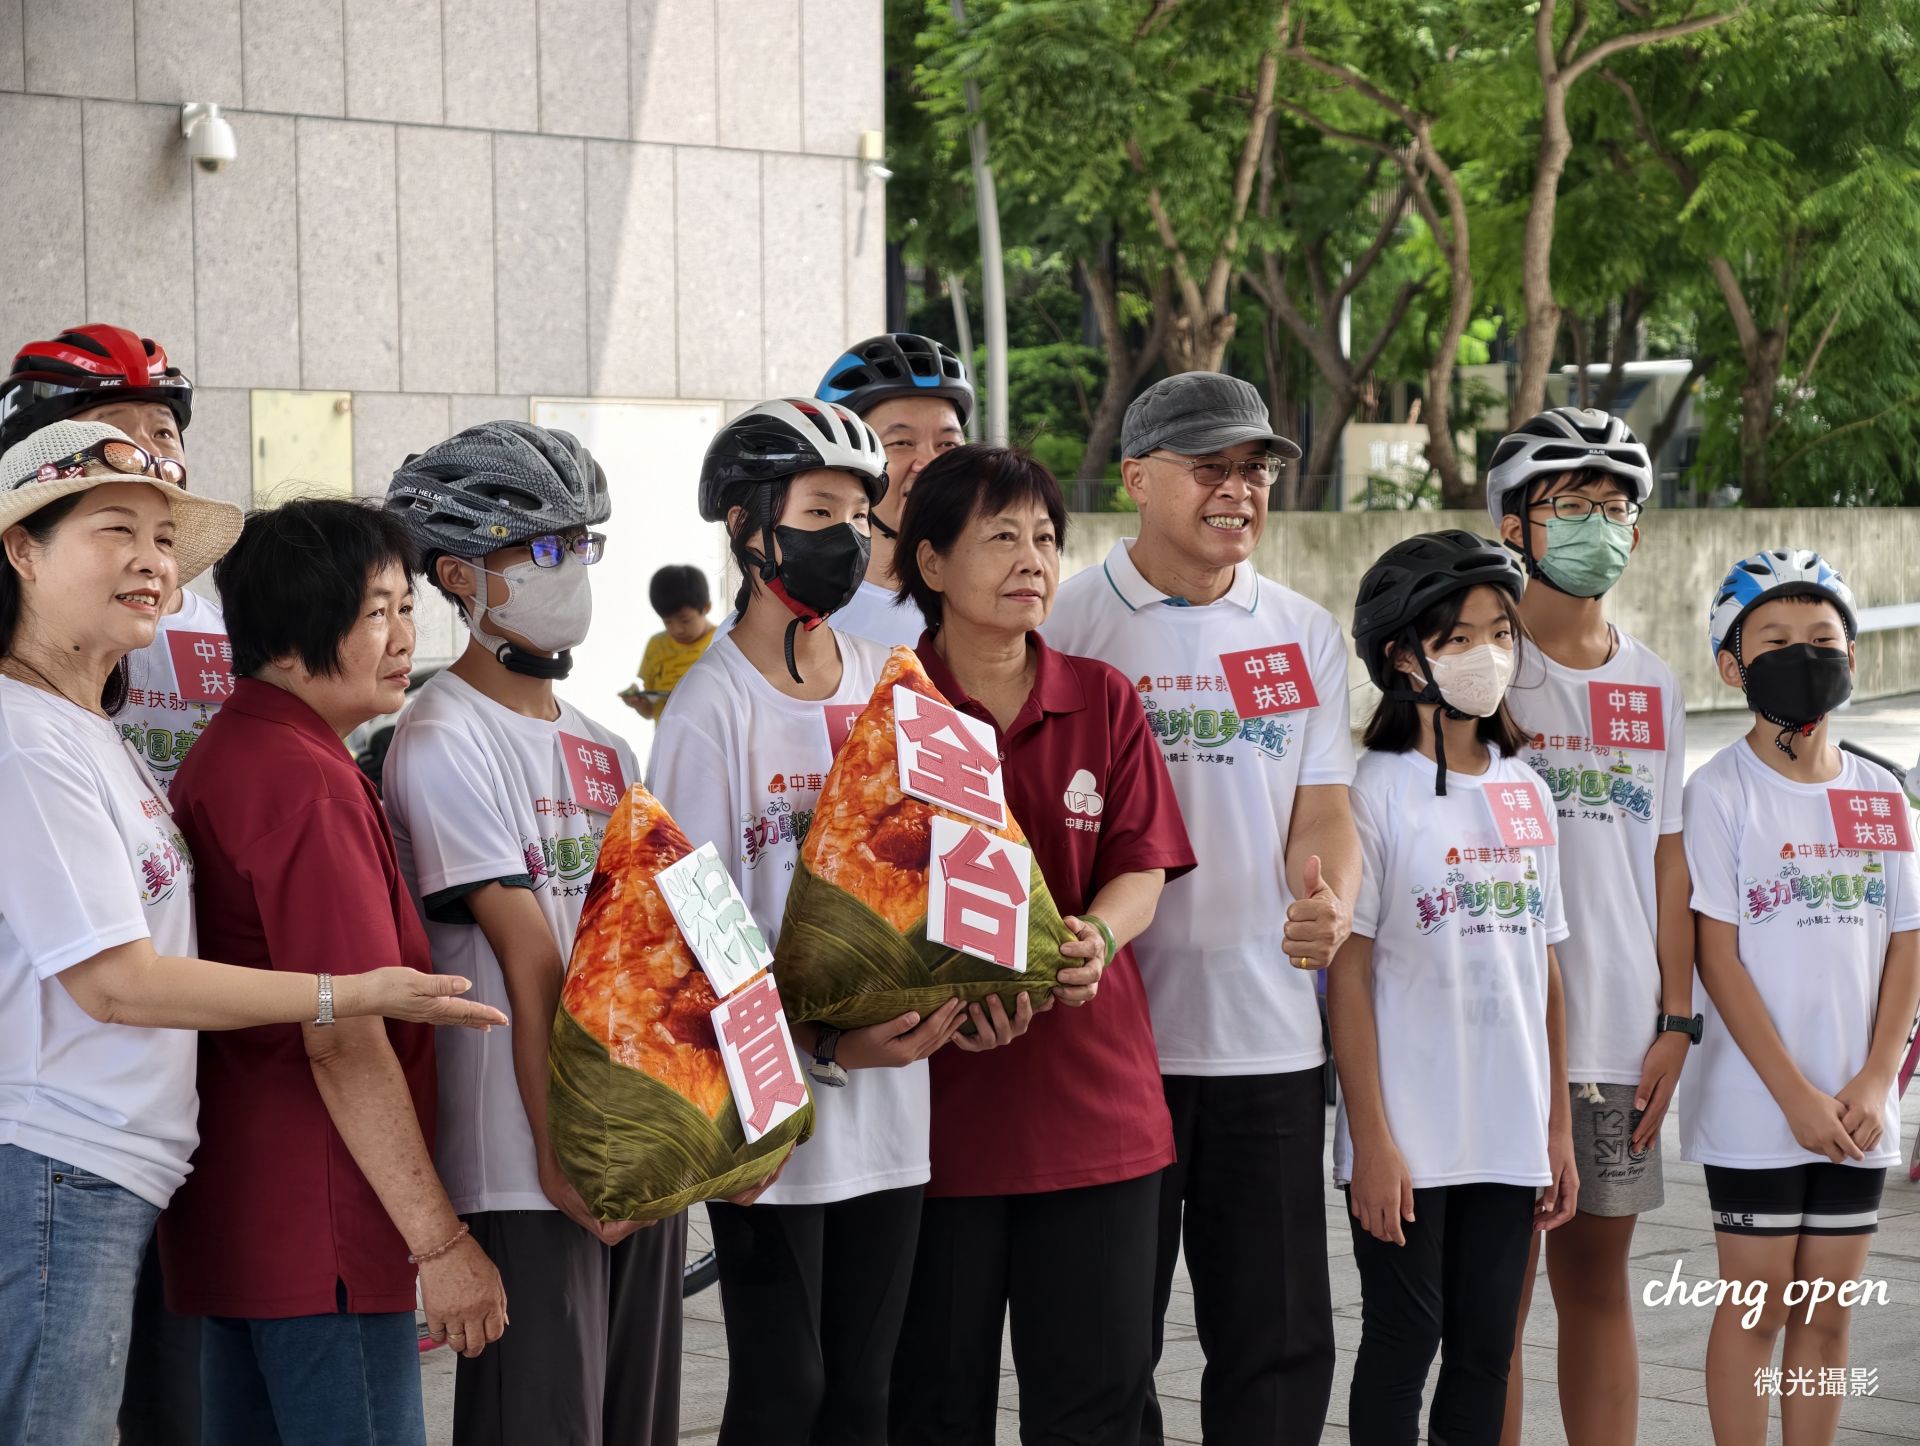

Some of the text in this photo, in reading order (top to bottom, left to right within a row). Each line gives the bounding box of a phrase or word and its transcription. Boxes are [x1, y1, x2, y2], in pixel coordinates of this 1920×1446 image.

[1244, 652, 1291, 679] 中華
[1253, 681, 1301, 710] 扶弱
[1609, 689, 1649, 714] 中華
[1610, 717, 1650, 744] 扶弱
[577, 744, 612, 775] 中華
[584, 775, 620, 808] 扶弱
[789, 773, 829, 792] 中華
[1501, 788, 1533, 812] 中華
[1849, 795, 1892, 818] 中華
[1511, 817, 1544, 841] 扶弱
[1854, 822, 1898, 846] 扶弱
[1463, 847, 1522, 864] 中華扶弱
